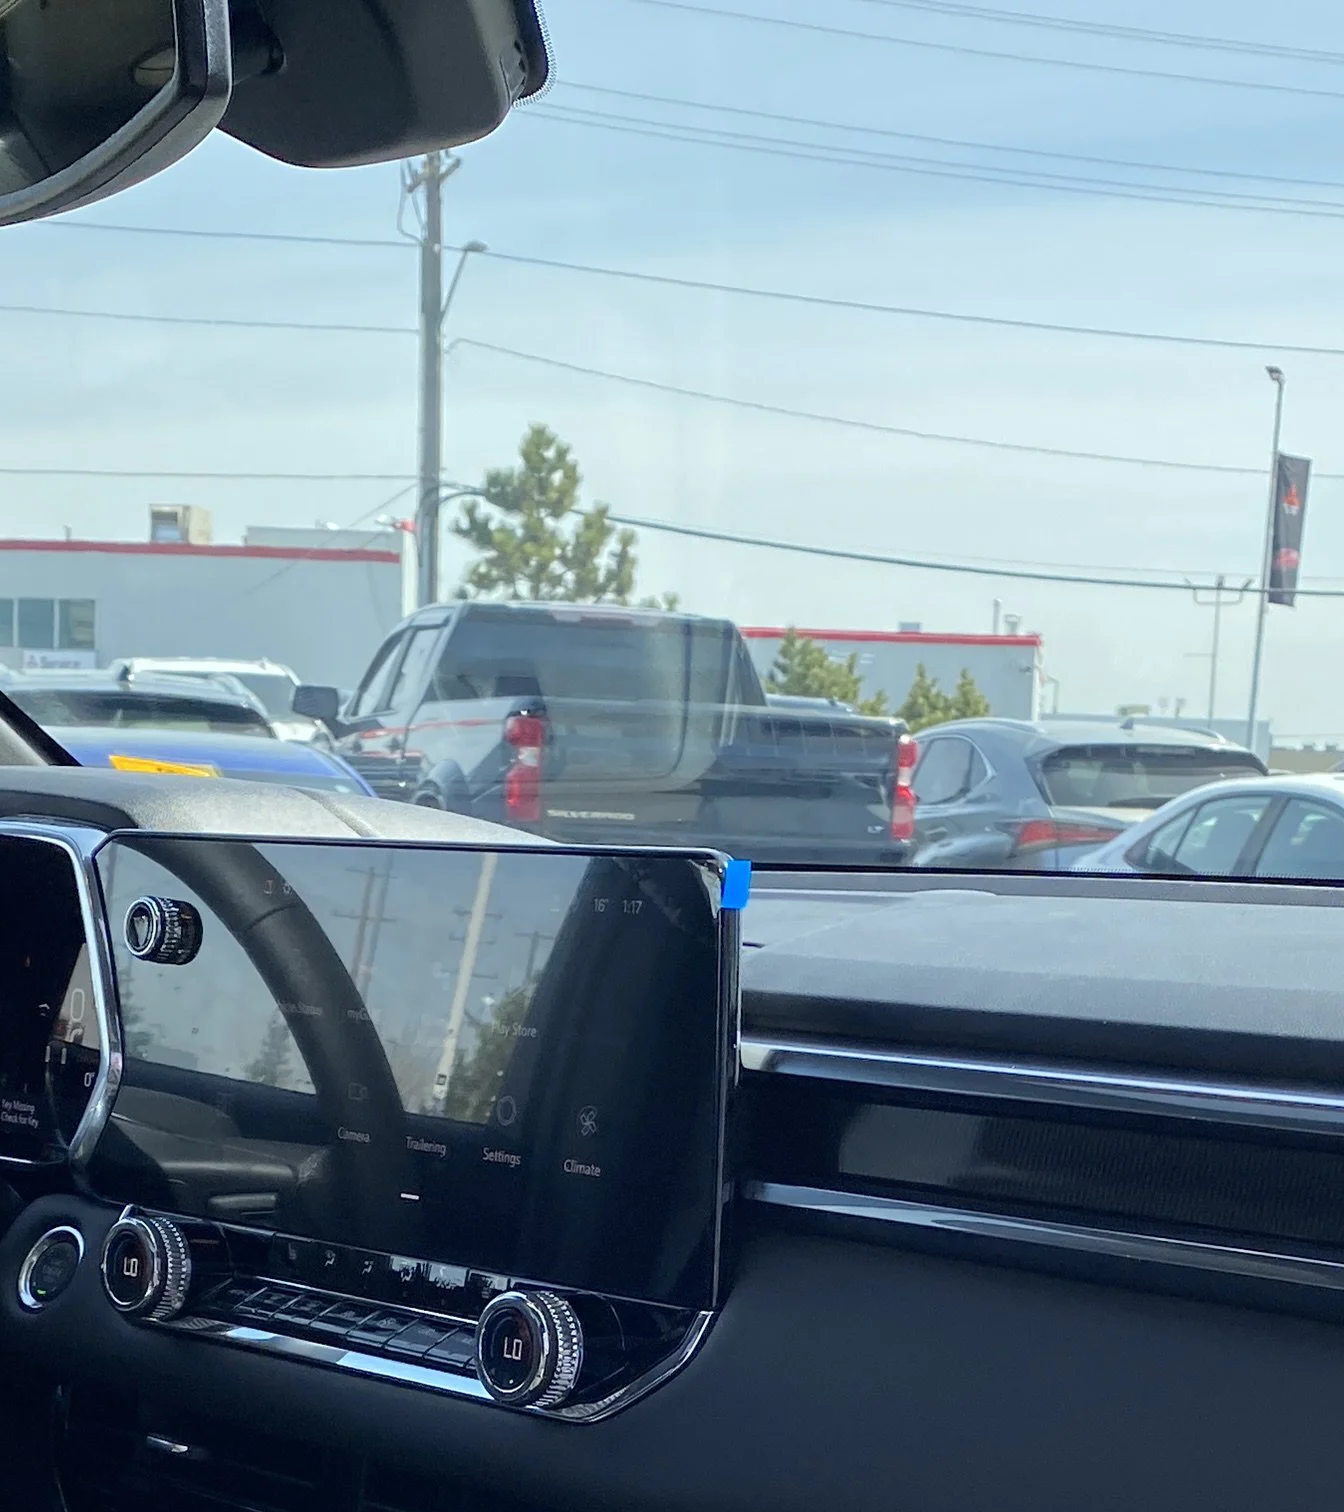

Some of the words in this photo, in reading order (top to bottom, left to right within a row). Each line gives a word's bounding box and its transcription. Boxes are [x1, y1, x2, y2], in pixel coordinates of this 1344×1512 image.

[546, 808, 637, 821] SILVERADO
[70, 987, 86, 1023] 0
[513, 1021, 537, 1038] Store
[337, 1126, 371, 1143] Camera
[405, 1136, 447, 1158] Trailering
[482, 1147, 522, 1168] Settings
[563, 1158, 602, 1178] Climate
